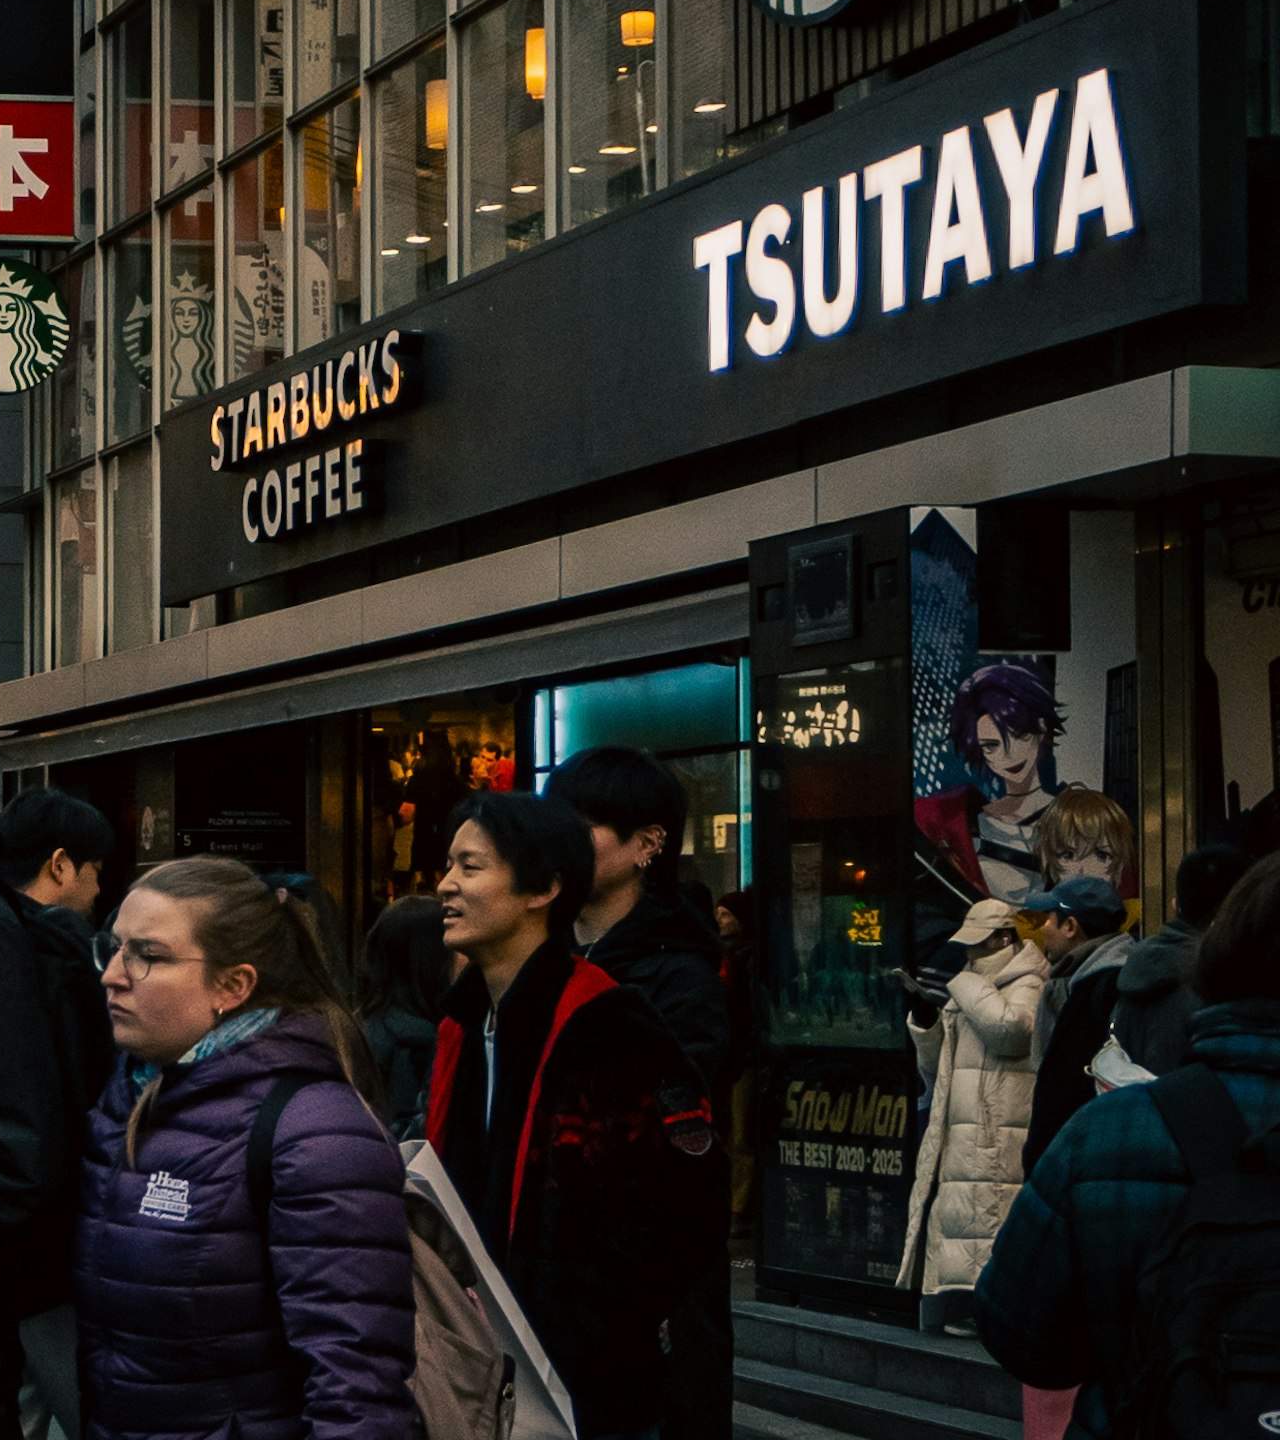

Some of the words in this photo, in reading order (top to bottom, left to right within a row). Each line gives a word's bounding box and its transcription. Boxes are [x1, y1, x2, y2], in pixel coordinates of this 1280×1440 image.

[692, 67, 1135, 374] TSUTAYA
[209, 328, 405, 473] STARBUCKS
[241, 438, 363, 544] COFFEE
[776, 1139, 801, 1167] THE
[802, 1140, 834, 1170] BEST
